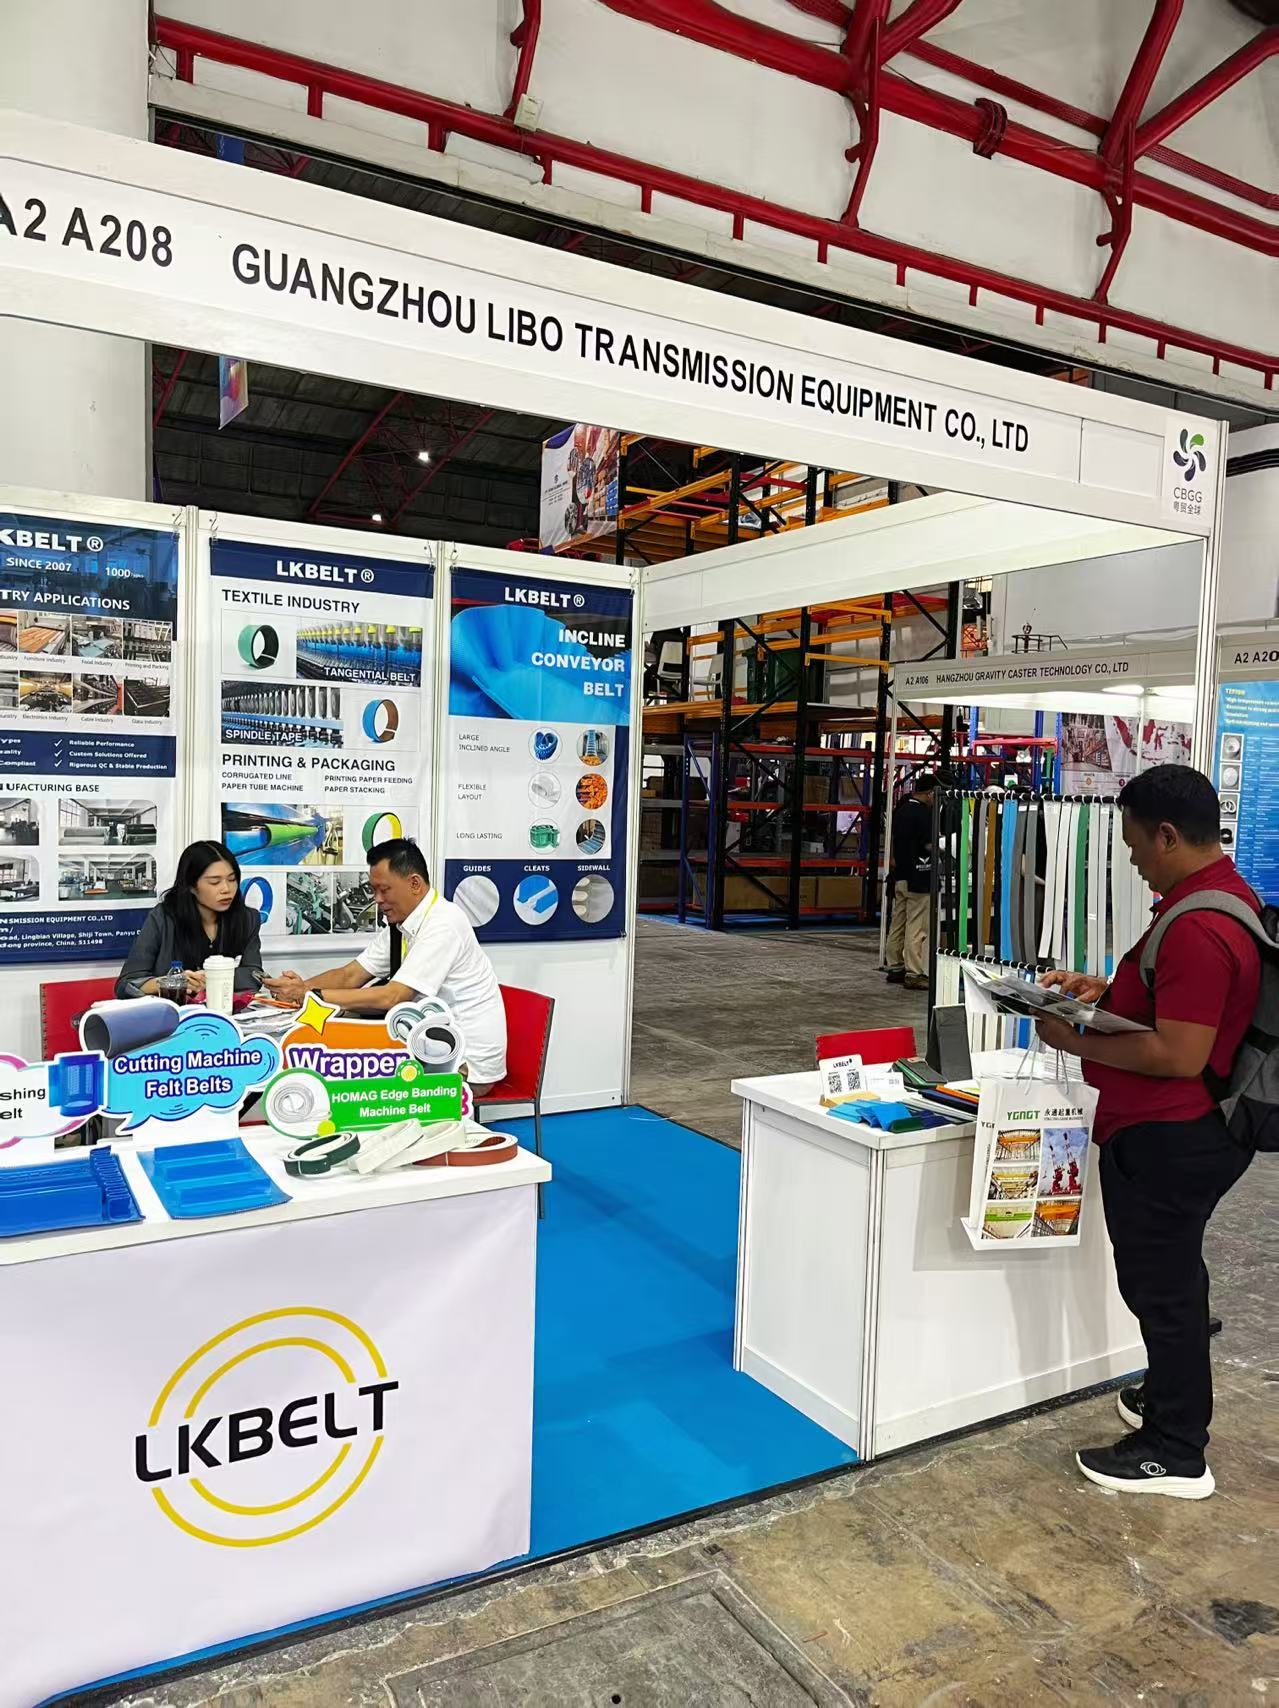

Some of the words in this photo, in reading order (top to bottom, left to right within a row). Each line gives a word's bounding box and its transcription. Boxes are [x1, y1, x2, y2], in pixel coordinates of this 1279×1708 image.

[62, 207, 173, 267] A208
[233, 244, 476, 333] GUANGZHOU
[488, 303, 563, 351] LIBO
[575, 322, 793, 403] TRANSMISSION
[801, 376, 937, 432] EQUIPMENT
[945, 409, 985, 449] CO.,
[992, 418, 1029, 452] LTD
[1173, 487, 1203, 503] CBGG
[6, 557, 42, 569] SINCE
[45, 560, 72, 572] 2007
[34, 592, 131, 610] APPLICATIONS
[222, 589, 283, 606] TEXTILE
[288, 596, 360, 613] INDUSTRY
[558, 629, 626, 648] INCLINE
[531, 652, 625, 672] CONVEYOR
[1234, 652, 1249, 664] A2
[324, 667, 388, 681] TANGENTIAL
[389, 673, 416, 682] BELT
[915, 675, 929, 685] A106
[936, 673, 974, 683] HANGZHOU
[975, 670, 1007, 681] GRAVITY
[1007, 667, 1037, 678] CASTER
[1040, 664, 1093, 677] TECHNOLOGY
[1113, 662, 1129, 672] LTD
[583, 682, 624, 697] BELT
[225, 729, 273, 741] SPINDLE
[274, 731, 303, 742] TAPE
[222, 754, 292, 768] PRINTING
[297, 757, 307, 769] &
[311, 758, 396, 772] PACKAGING
[222, 772, 274, 781] CORRUGATED
[275, 773, 293, 781] LINE
[324, 775, 357, 783] PRINTING
[359, 776, 383, 784] PAPER
[75, 784, 100, 793] BASE
[249, 783, 269, 791] TUBE
[270, 784, 304, 792] MACHINE
[349, 786, 386, 794] STACKING
[456, 832, 475, 840] LONG
[463, 864, 492, 872] GUIDES
[114, 1056, 182, 1074] Cutting
[188, 1049, 261, 1068] Machine
[290, 1049, 406, 1078] Wrapper
[146, 1079, 182, 1097] Felt
[187, 1077, 232, 1095] Belts
[332, 1090, 377, 1103] HOMAG
[380, 1089, 409, 1103] Edge
[411, 1086, 457, 1099] Banding
[359, 1105, 406, 1118] Machine
[409, 1104, 431, 1115] Belt
[135, 1380, 399, 1482] LKBELT
